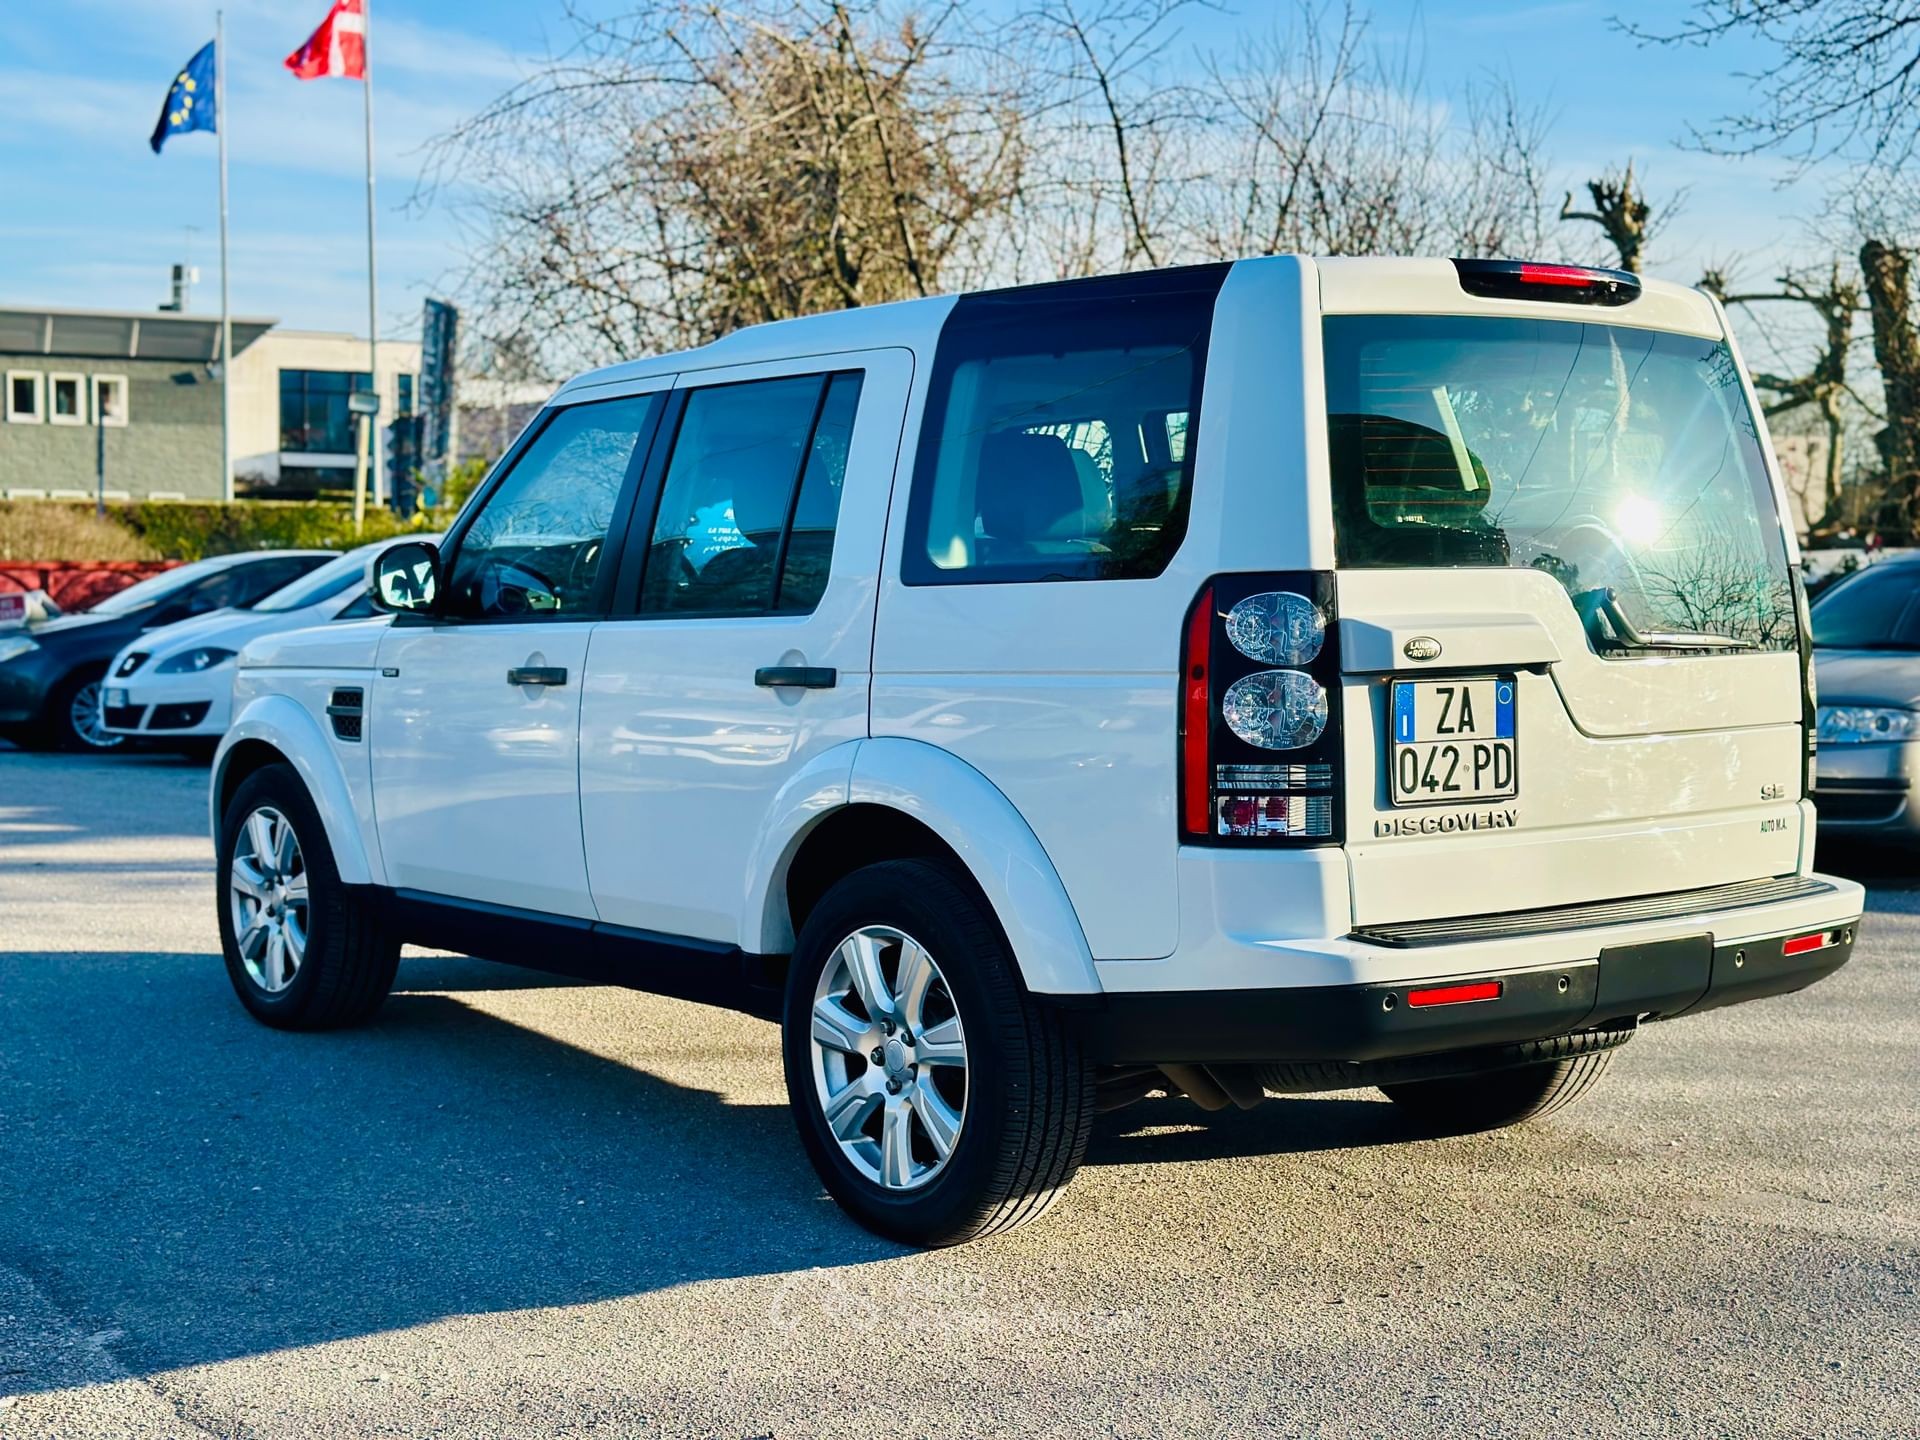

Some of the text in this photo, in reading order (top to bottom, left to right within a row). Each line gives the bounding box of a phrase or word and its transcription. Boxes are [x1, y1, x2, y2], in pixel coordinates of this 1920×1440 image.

[1410, 641, 1431, 649] LAND
[1412, 649, 1435, 657] ROVER
[1436, 686, 1475, 734] ZA
[1399, 743, 1512, 793] 042 PD
[1760, 783, 1785, 800] SE
[1374, 809, 1521, 838] DISCOVERY
[1760, 819, 1775, 833] AUTO
